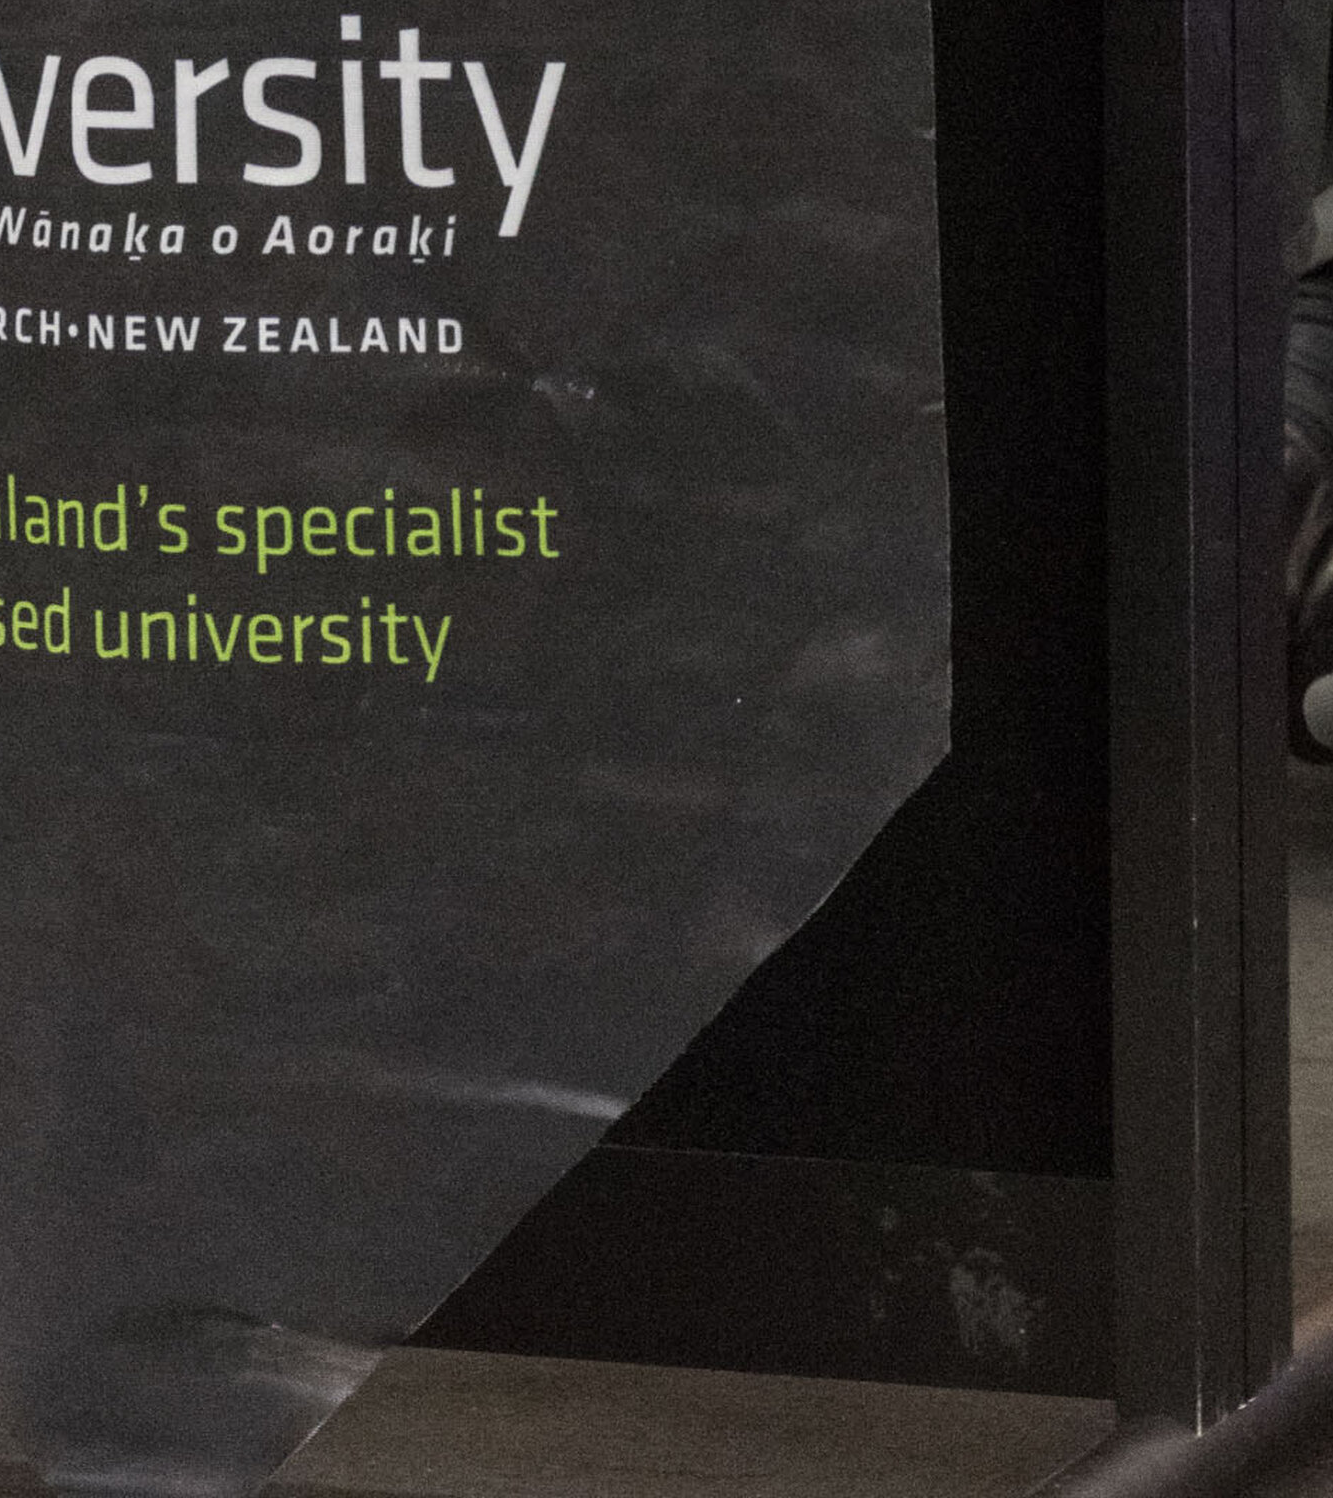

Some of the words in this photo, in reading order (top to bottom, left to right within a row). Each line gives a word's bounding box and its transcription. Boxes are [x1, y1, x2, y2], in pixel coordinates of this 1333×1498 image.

[210, 223, 239, 256] o
[221, 315, 464, 355] ZEALAND
[215, 486, 561, 576] specialist
[93, 592, 452, 684] university
